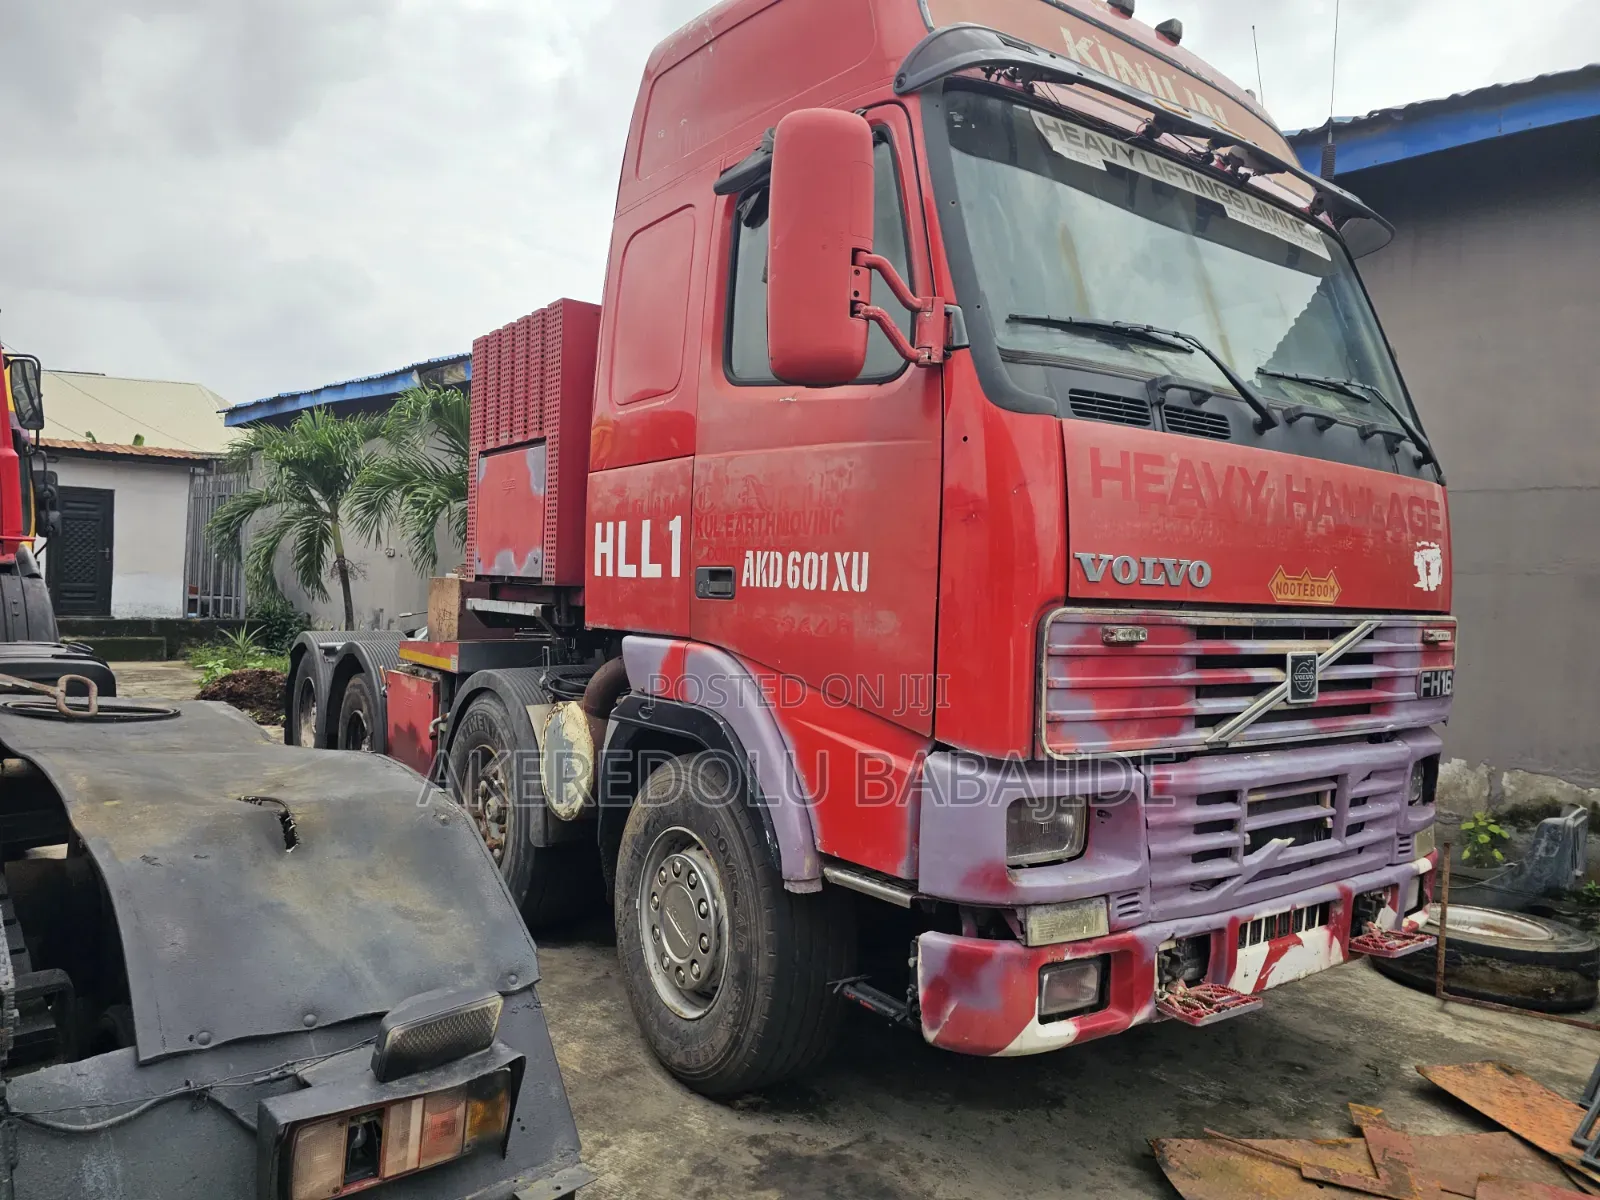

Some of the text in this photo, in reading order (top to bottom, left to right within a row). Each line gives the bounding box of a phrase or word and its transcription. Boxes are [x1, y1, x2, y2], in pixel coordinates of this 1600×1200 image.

[1038, 115, 1322, 245] HEAVY LIFTINGS LIMITED
[1089, 447, 1268, 515] HEAVY
[1285, 474, 1443, 541] HAULAGE
[594, 515, 681, 578] HLL 1
[741, 550, 781, 588] AKD
[787, 550, 828, 590] 601
[832, 551, 869, 592] XU
[1074, 552, 1212, 588] VOLVO
[1275, 580, 1336, 599] NOOTEBOOM
[1293, 673, 1315, 681] VOLVO
[1420, 670, 1453, 697] FH16
